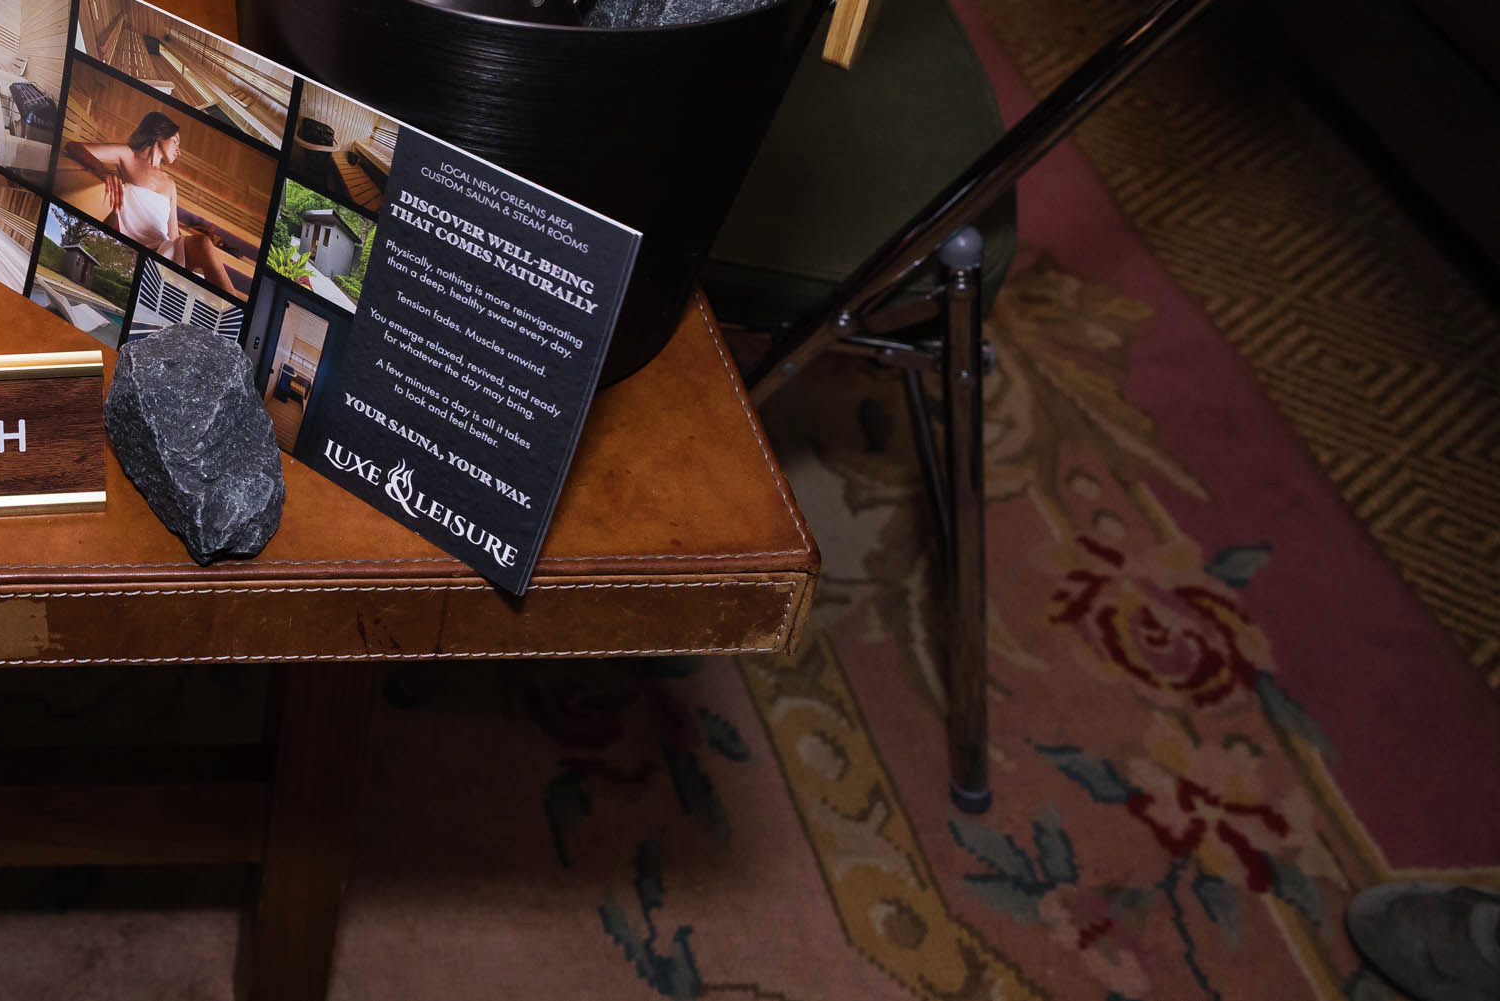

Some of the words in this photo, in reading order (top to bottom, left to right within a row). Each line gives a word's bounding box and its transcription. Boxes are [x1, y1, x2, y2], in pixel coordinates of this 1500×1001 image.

[399, 190, 485, 241] DISCOVER
[488, 233, 595, 294] WELL-BEING
[420, 166, 464, 194] CUSTOM
[464, 187, 501, 212] SAUNA
[501, 205, 511, 217] &
[511, 209, 546, 233] STEAM
[546, 226, 589, 254] ROOMS
[439, 161, 471, 184] LOCAL
[471, 176, 500, 196] NEW
[499, 190, 547, 219] ORLEANS
[546, 213, 574, 233] AREA
[385, 238, 434, 273] Physically,
[435, 267, 473, 293] nothing
[474, 284, 483, 297] is
[484, 291, 511, 310] more
[511, 306, 584, 350] reinvigorating
[386, 255, 409, 274] than
[409, 269, 418, 279] a
[418, 272, 447, 295] deep,
[448, 285, 486, 315] healthy
[486, 309, 518, 330] sweat
[518, 325, 549, 347] every
[549, 339, 573, 359] day.
[389, 202, 435, 234] THAT
[434, 226, 493, 263] COMES
[492, 253, 599, 315] NATURALLY
[369, 306, 387, 324] You
[387, 320, 425, 344] emerge
[425, 339, 465, 367] relaxed,
[466, 361, 505, 389] revived,
[507, 384, 530, 400] and
[529, 395, 562, 418] ready
[383, 329, 398, 345] for
[398, 340, 444, 369] whatever
[443, 363, 460, 379] the
[460, 373, 482, 392] day
[481, 386, 505, 404] may
[505, 395, 535, 421] bring.
[396, 290, 432, 317] Tension
[432, 308, 462, 334] fades.
[464, 327, 505, 356] Muscles
[506, 351, 546, 378] unwind.
[344, 392, 387, 427] YOUR
[388, 419, 444, 461] SAUNA,
[447, 450, 492, 487] YOUR
[494, 479, 531, 509] WAY.
[374, 357, 384, 369] A
[385, 361, 404, 379] few
[404, 375, 441, 400] minutes
[441, 395, 450, 405] a
[450, 399, 471, 417] day
[471, 409, 480, 422] is
[481, 417, 496, 430] all
[495, 423, 504, 434] it
[503, 428, 531, 450] takes
[393, 383, 404, 395] to
[404, 387, 427, 408] look
[427, 403, 449, 420] and
[448, 411, 469, 431] feel
[468, 422, 499, 449] better.
[324, 439, 383, 486] LUXE
[413, 491, 519, 568] LEISURE
